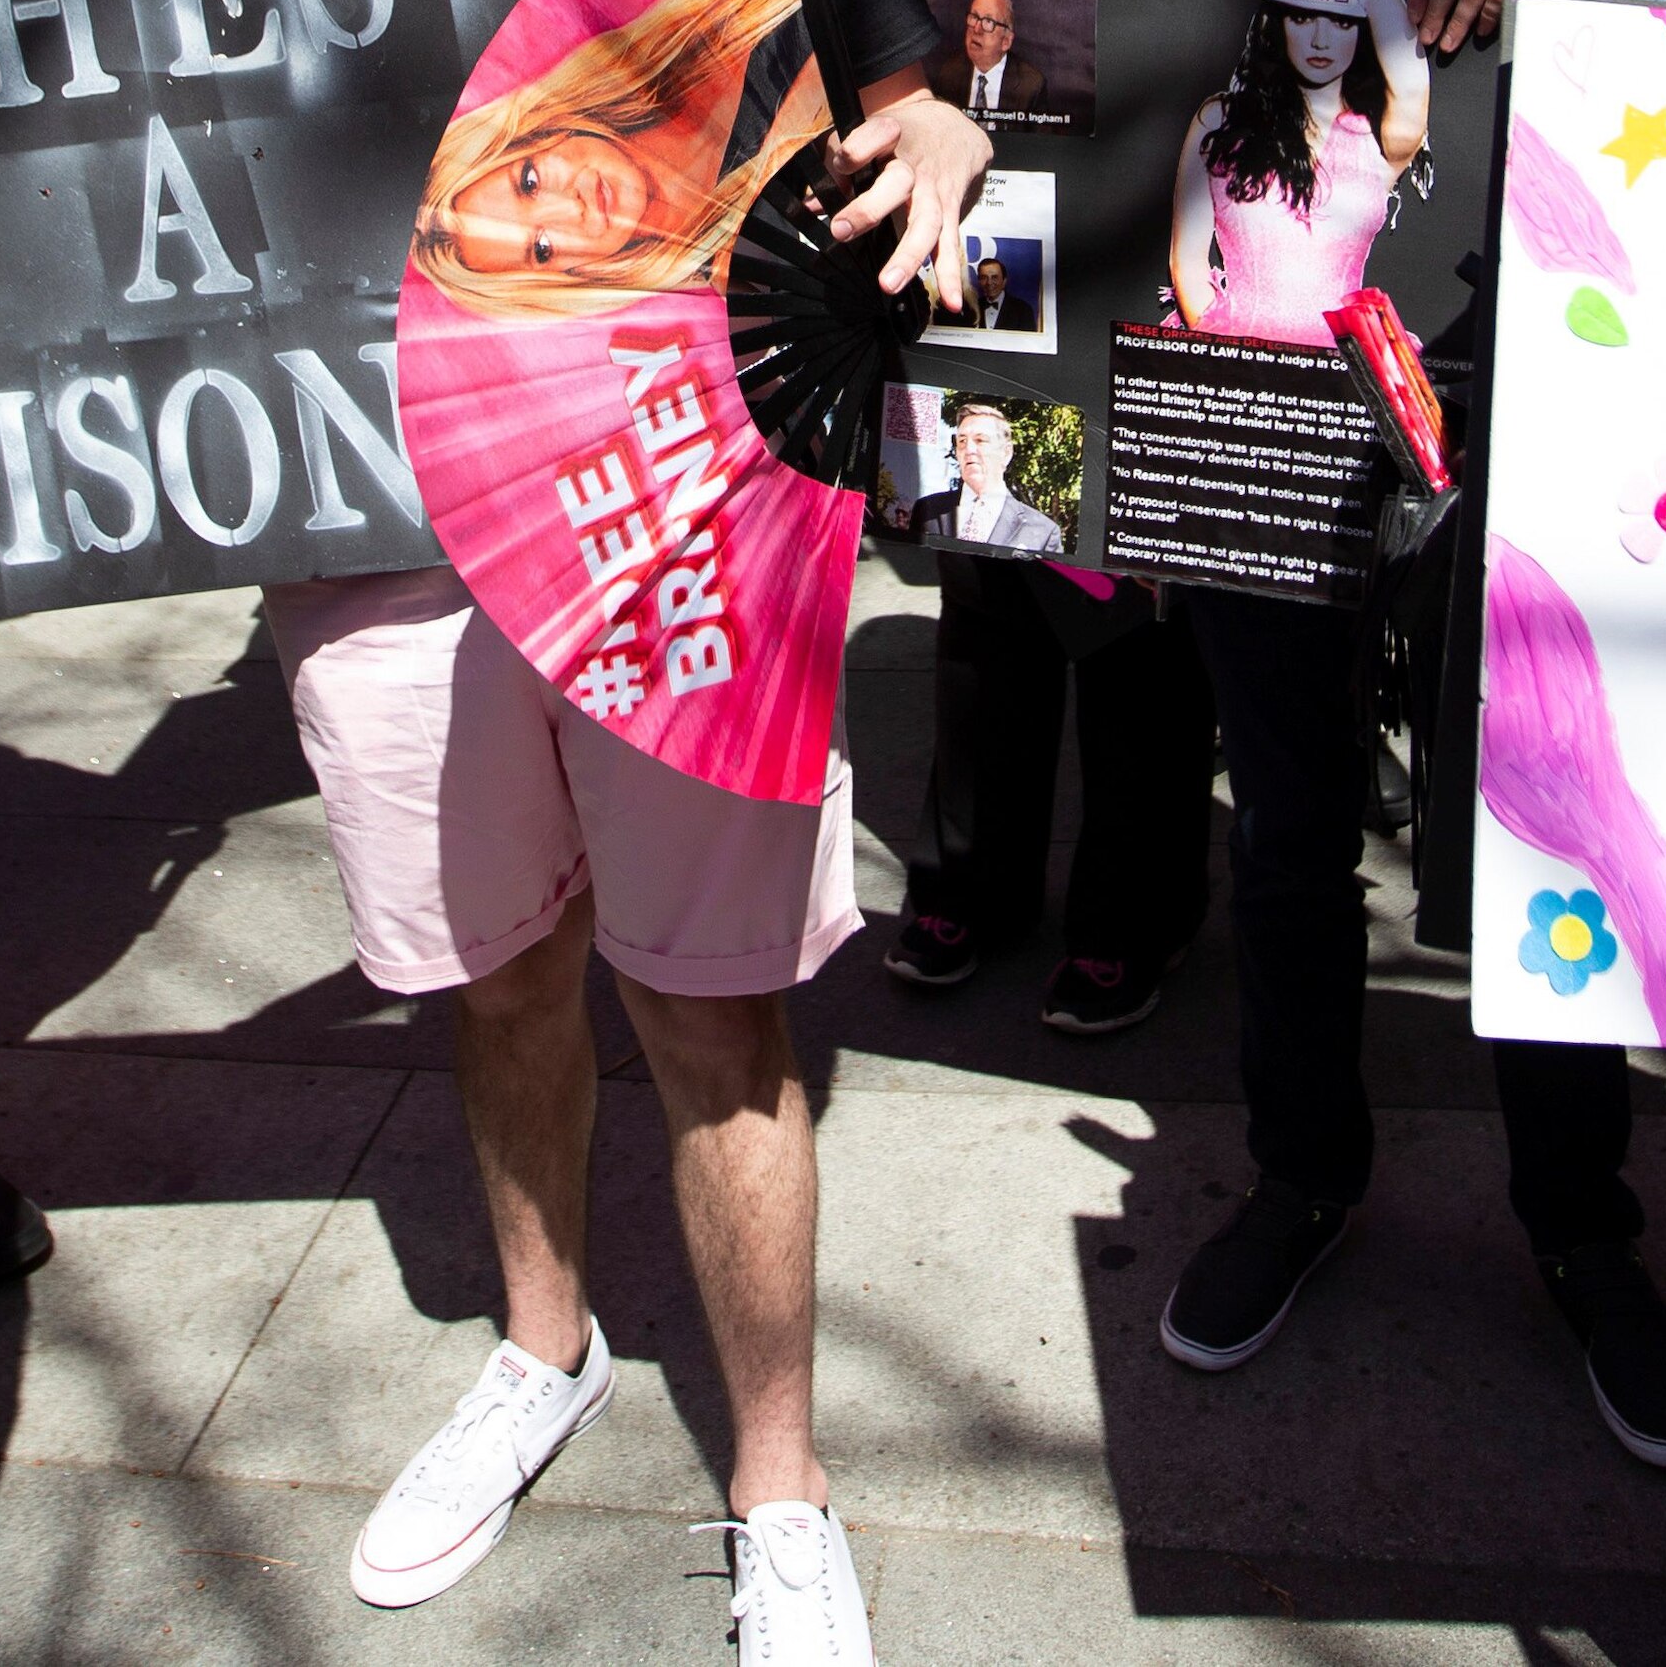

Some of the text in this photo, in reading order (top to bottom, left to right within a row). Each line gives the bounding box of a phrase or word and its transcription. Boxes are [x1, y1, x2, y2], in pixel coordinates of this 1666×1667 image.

[983, 110, 1016, 120] Samuel
[1029, 112, 1063, 124] Ingham
[125, 114, 253, 303] A
[1116, 335, 1188, 353] PROFESSOR
[1191, 344, 1208, 354] OF
[1210, 345, 1240, 359] LAW
[1241, 350, 1254, 360] to
[1256, 351, 1275, 363] the
[1277, 354, 1315, 368] Judge
[1317, 357, 1329, 369] in
[1114, 374, 1367, 414] In other words the Judge did not respect the
[1115, 389, 1159, 403] violated
[1161, 393, 1202, 409] Britney
[1204, 398, 1248, 413] Spears'
[1249, 404, 1283, 418] rights
[1285, 408, 1317, 422] when
[1319, 413, 1342, 425] she
[1114, 402, 1361, 440] conservatorship and denied her the right to
[1112, 440, 1141, 454] being
[1208, 453, 1257, 468] delivered
[1259, 459, 1271, 470] to
[1273, 461, 1291, 473] the
[1292, 463, 1344, 480] proposed
[1139, 432, 1223, 451] conservatorship
[1225, 442, 1248, 454] was
[1249, 445, 1291, 460] granted
[1293, 450, 1332, 465] without
[1133, 468, 1175, 483] Reason
[1176, 474, 1189, 485] of
[1189, 476, 1246, 495] dispensing
[1247, 484, 1269, 496] that
[1271, 488, 1304, 502] notice
[1306, 493, 1330, 505] was
[1331, 495, 1362, 509] given
[608, 337, 735, 697] BRINEY
[1110, 505, 1124, 518] by
[1125, 508, 1134, 517] a
[1117, 492, 1128, 504] A
[1128, 495, 1178, 511] proposed
[1179, 503, 1245, 521] conservatee
[1273, 514, 1291, 526] the
[1293, 517, 1318, 532] right
[1319, 521, 1331, 533] to
[1333, 524, 1374, 539] choose
[1108, 544, 1315, 584] temporary conservatorship was granted
[1116, 531, 1184, 550] Conservatee
[1186, 543, 1208, 554] was
[1210, 547, 1227, 558] not
[1229, 548, 1259, 562] given
[1260, 552, 1278, 564] the
[1280, 555, 1305, 570] right
[1306, 559, 1318, 570] to
